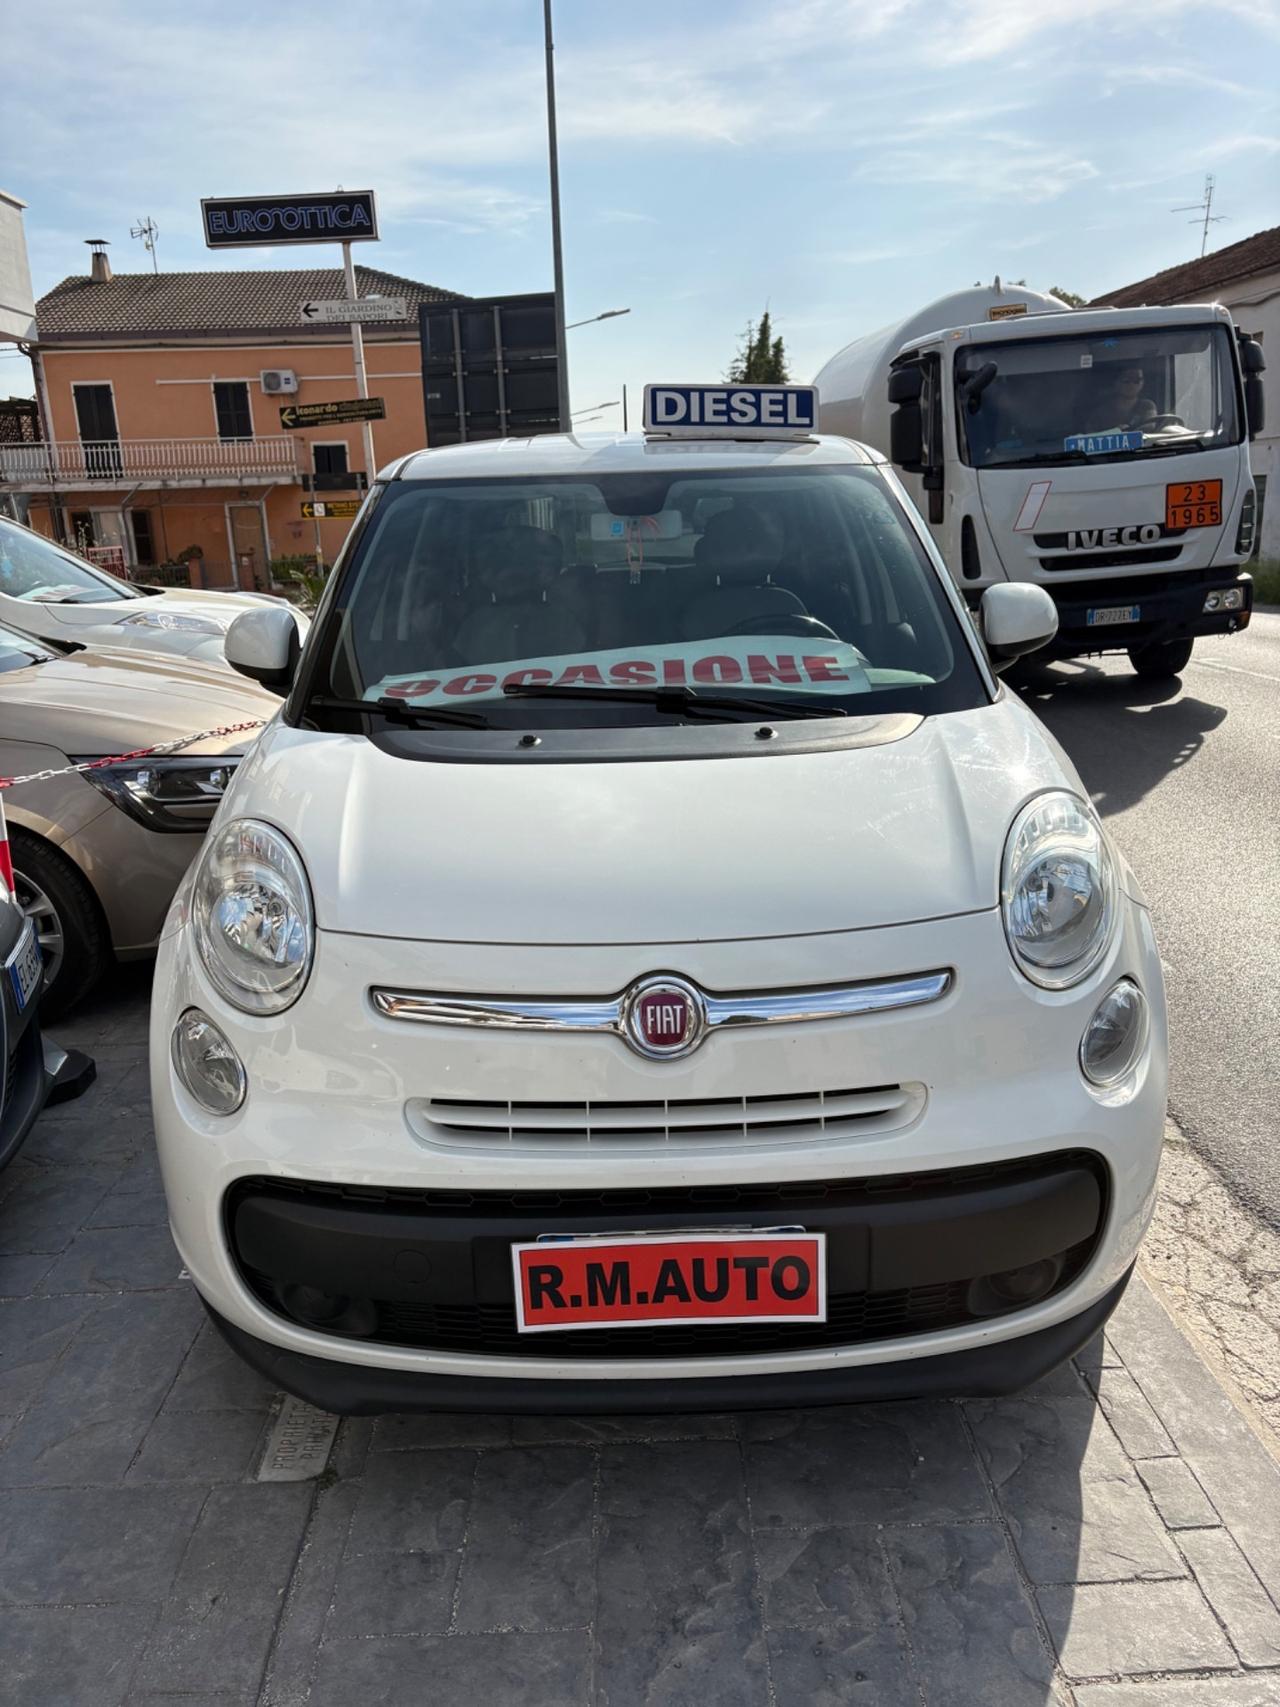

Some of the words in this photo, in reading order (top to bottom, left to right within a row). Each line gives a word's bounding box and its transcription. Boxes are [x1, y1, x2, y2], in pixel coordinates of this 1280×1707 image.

[325, 306, 336, 314] IL
[338, 304, 393, 313] GIARDINO
[655, 391, 811, 424] DIESEL
[1077, 434, 1130, 451] MATTIA
[1183, 484, 1207, 502] 23
[1170, 505, 1219, 527] 1965
[1067, 524, 1161, 551] IVECO
[384, 654, 850, 698] OCCASIONE
[646, 1005, 684, 1035] FIAT
[527, 1255, 812, 1311] R.M.AUTO
